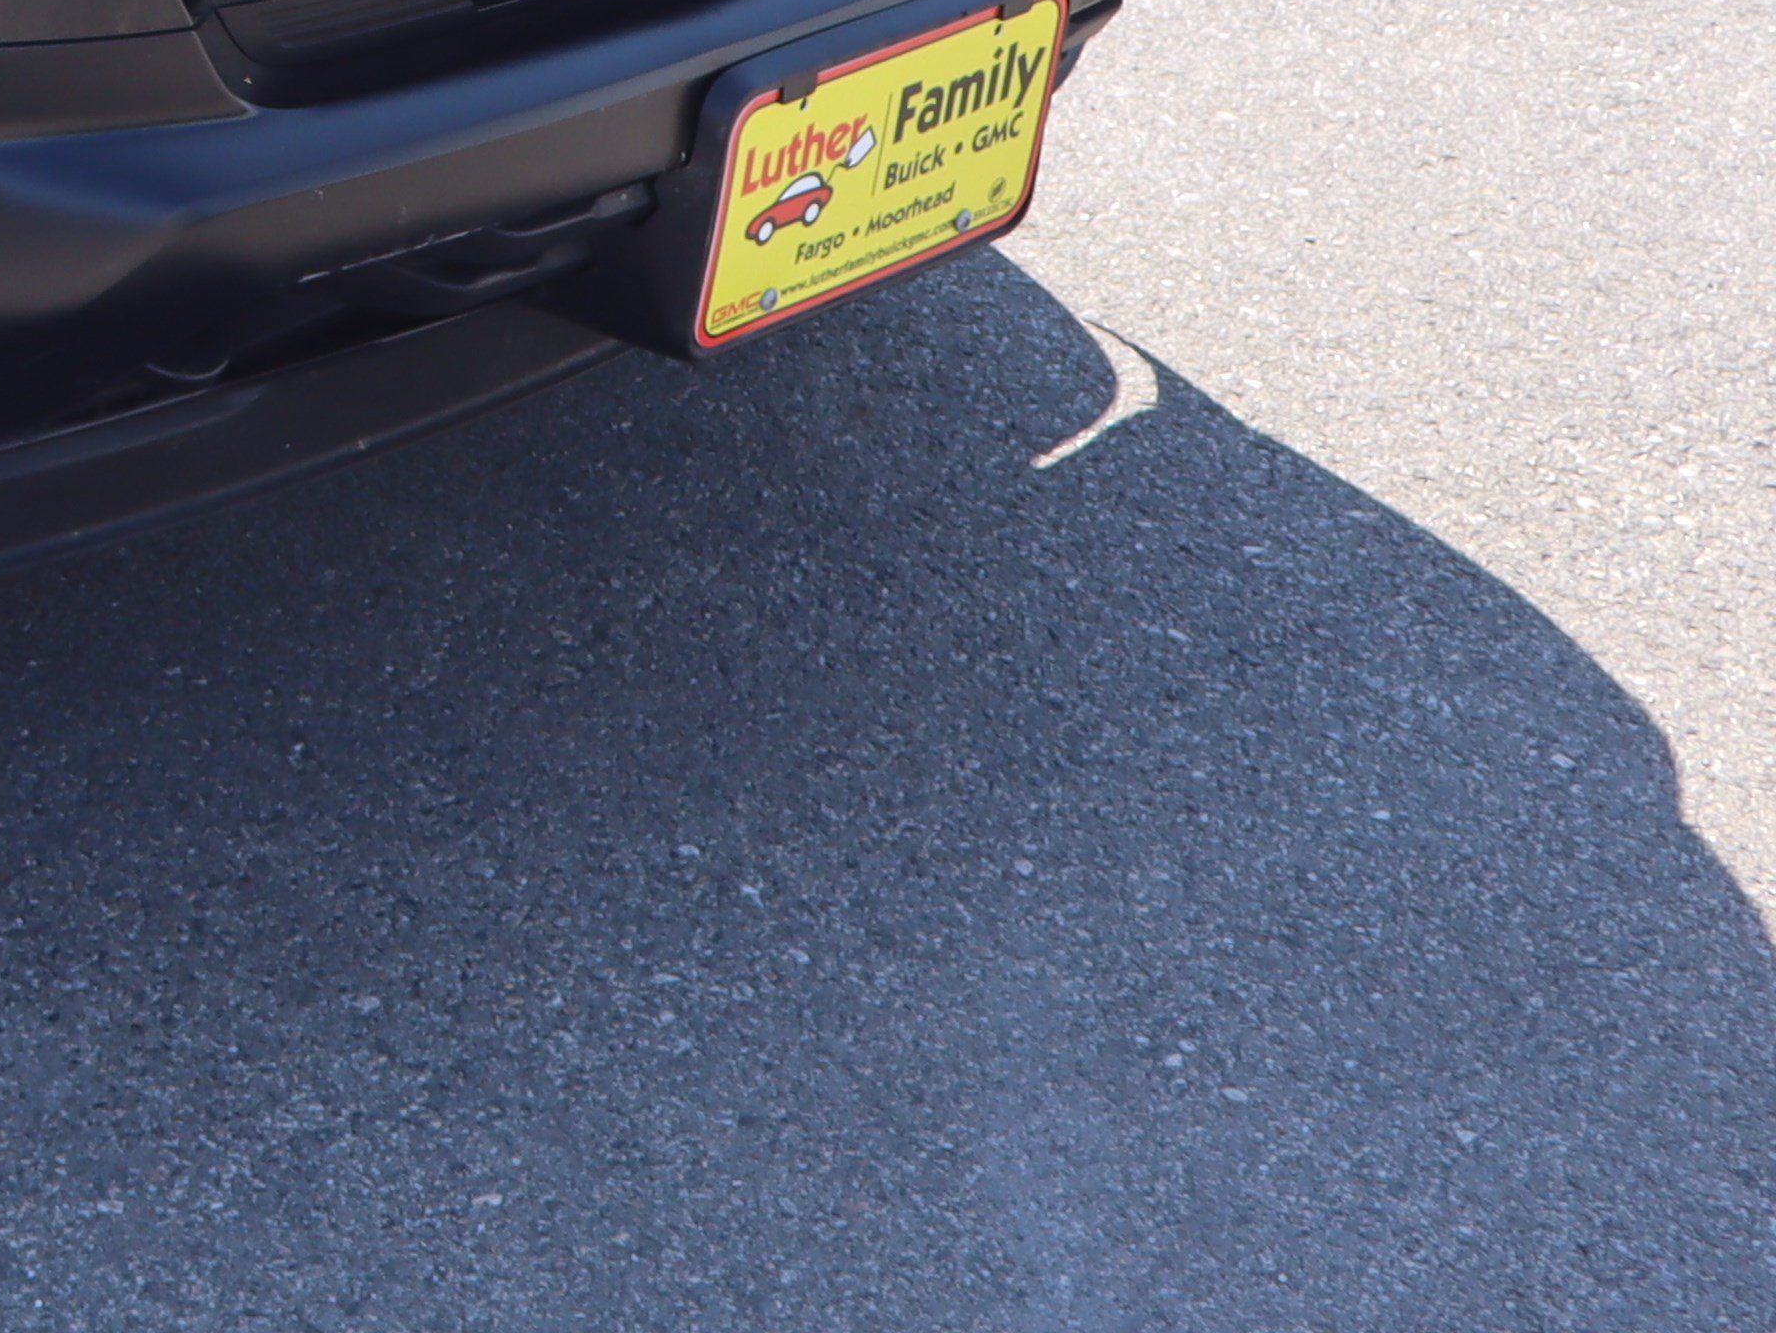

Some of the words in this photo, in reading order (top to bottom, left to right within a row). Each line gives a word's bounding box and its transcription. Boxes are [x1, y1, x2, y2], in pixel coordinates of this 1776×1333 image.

[893, 41, 1046, 144] Family
[740, 113, 868, 197] Luther
[884, 144, 946, 190] Buick
[972, 111, 1024, 153] GMC
[794, 231, 846, 265] Fargo
[864, 181, 956, 237] Moorhead
